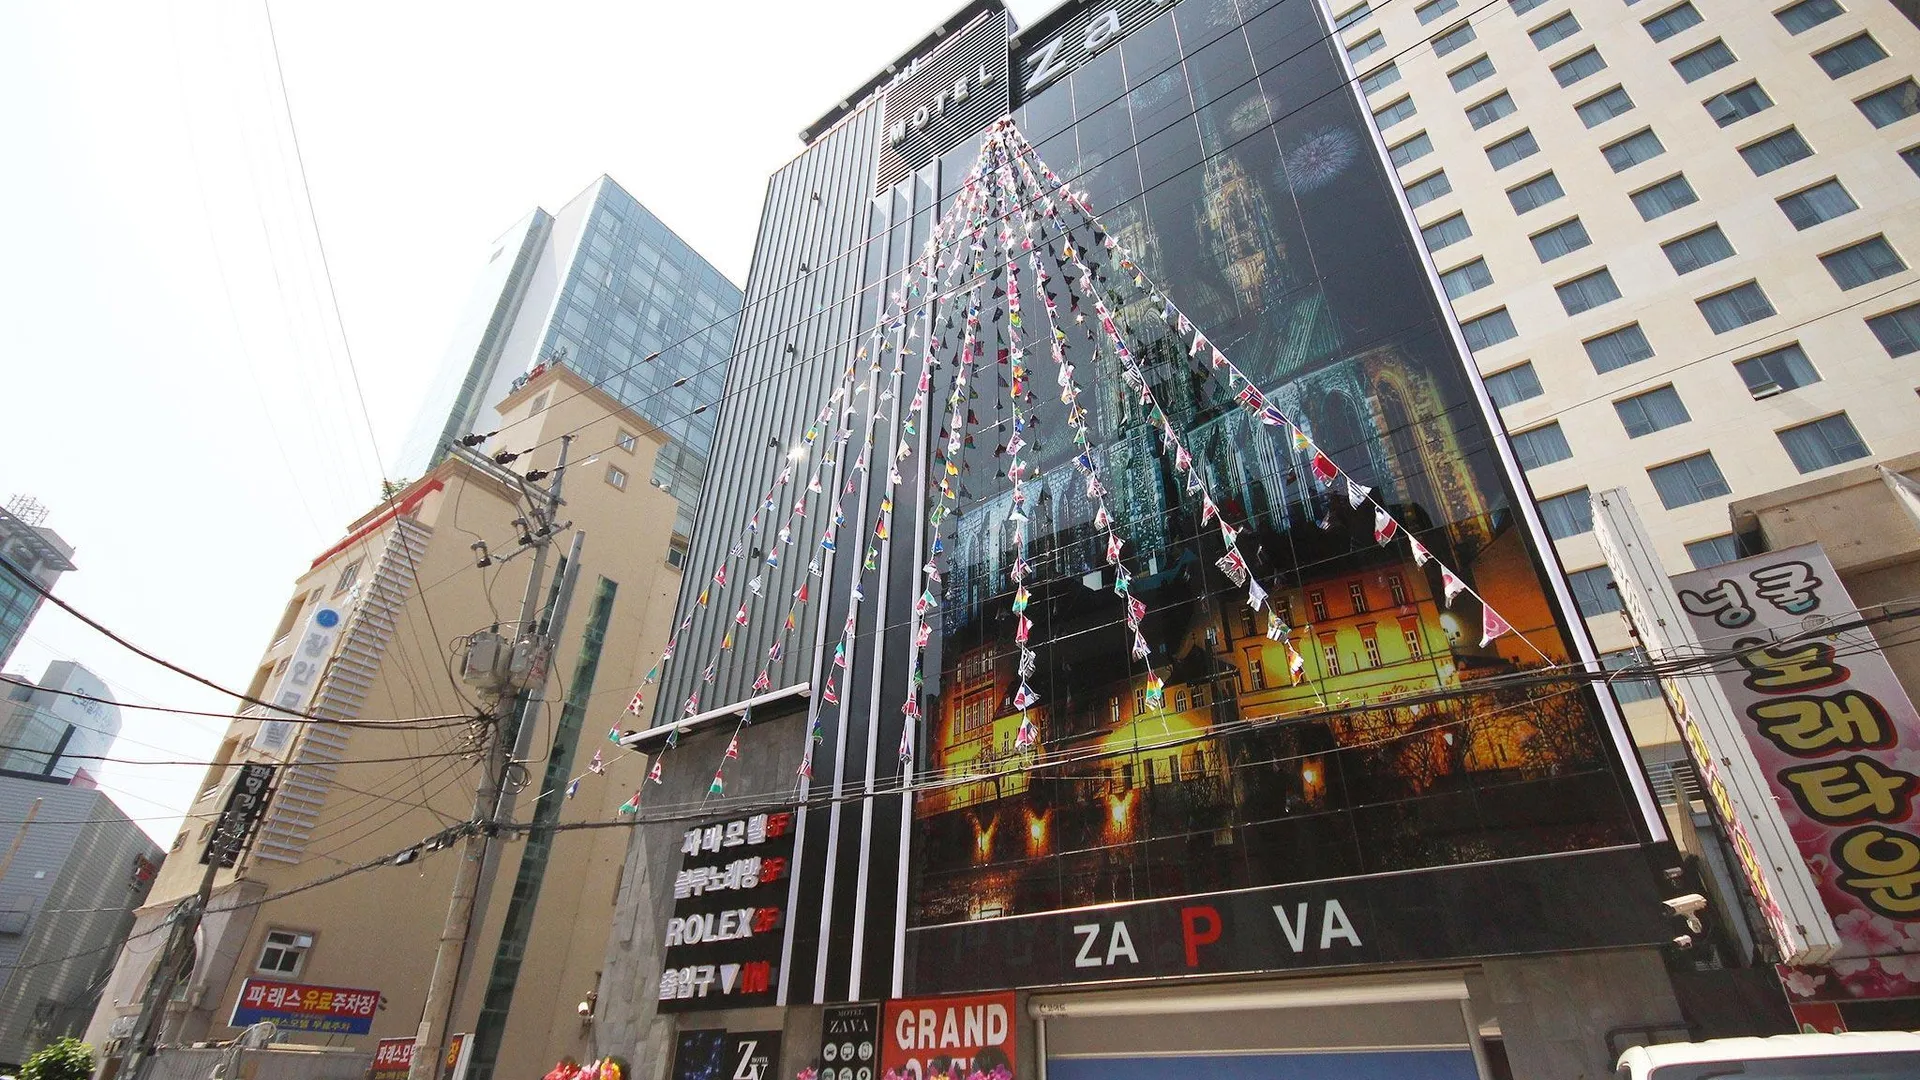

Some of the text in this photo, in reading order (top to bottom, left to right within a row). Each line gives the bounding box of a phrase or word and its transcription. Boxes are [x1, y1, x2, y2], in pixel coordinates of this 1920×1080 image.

[889, 64, 994, 149] MOTEL
[1678, 560, 1824, 629] 넝쿨
[1732, 636, 1920, 923] 노래타운
[681, 813, 768, 856] 자바모텔
[674, 856, 762, 899] 블루노래방
[665, 906, 780, 947] ROLEX 2F
[1073, 899, 1363, 967] ZA P VA
[246, 986, 301, 1008] 파래스
[659, 960, 771, 1000] 출입구 IN
[829, 1019, 869, 1033] ZAVA
[895, 1003, 1009, 1051] GRAND
